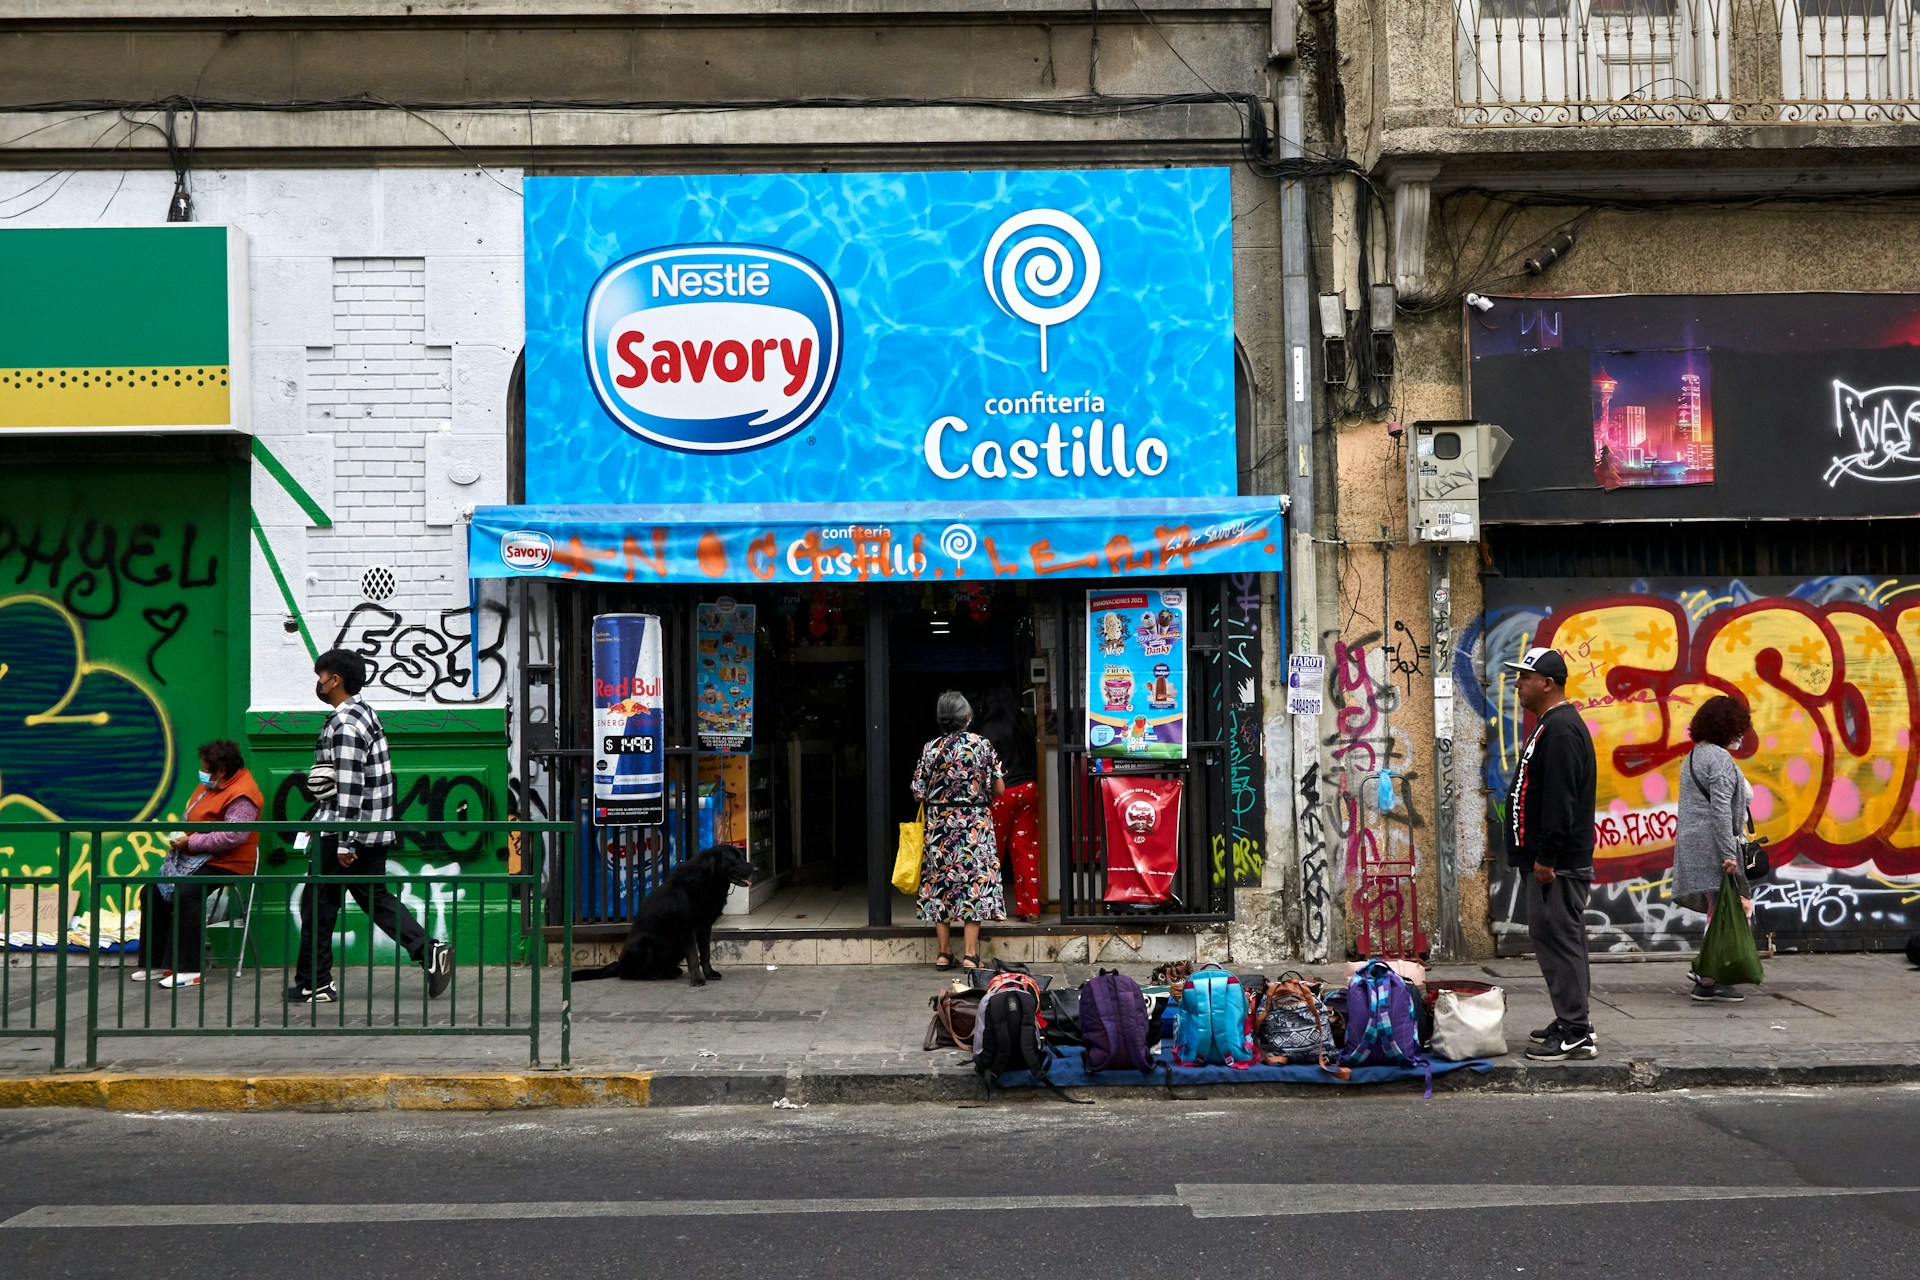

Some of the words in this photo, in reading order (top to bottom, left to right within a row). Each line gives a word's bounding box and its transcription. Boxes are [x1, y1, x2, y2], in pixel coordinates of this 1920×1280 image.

[652, 263, 770, 297] Nestlé
[616, 330, 813, 397] Savory
[984, 390, 1105, 414] confitería
[924, 416, 1168, 479] Castillo
[822, 525, 891, 539] conftería
[506, 545, 548, 561] Savory
[1093, 598, 1130, 607] INNOVACIONES
[1146, 645, 1171, 655] Danky
[1293, 656, 1322, 667] TAROT
[595, 676, 628, 697] Red
[631, 677, 662, 697] Bull
[597, 719, 631, 727] ENERG
[605, 739, 614, 751] $
[621, 736, 653, 753] 1490
